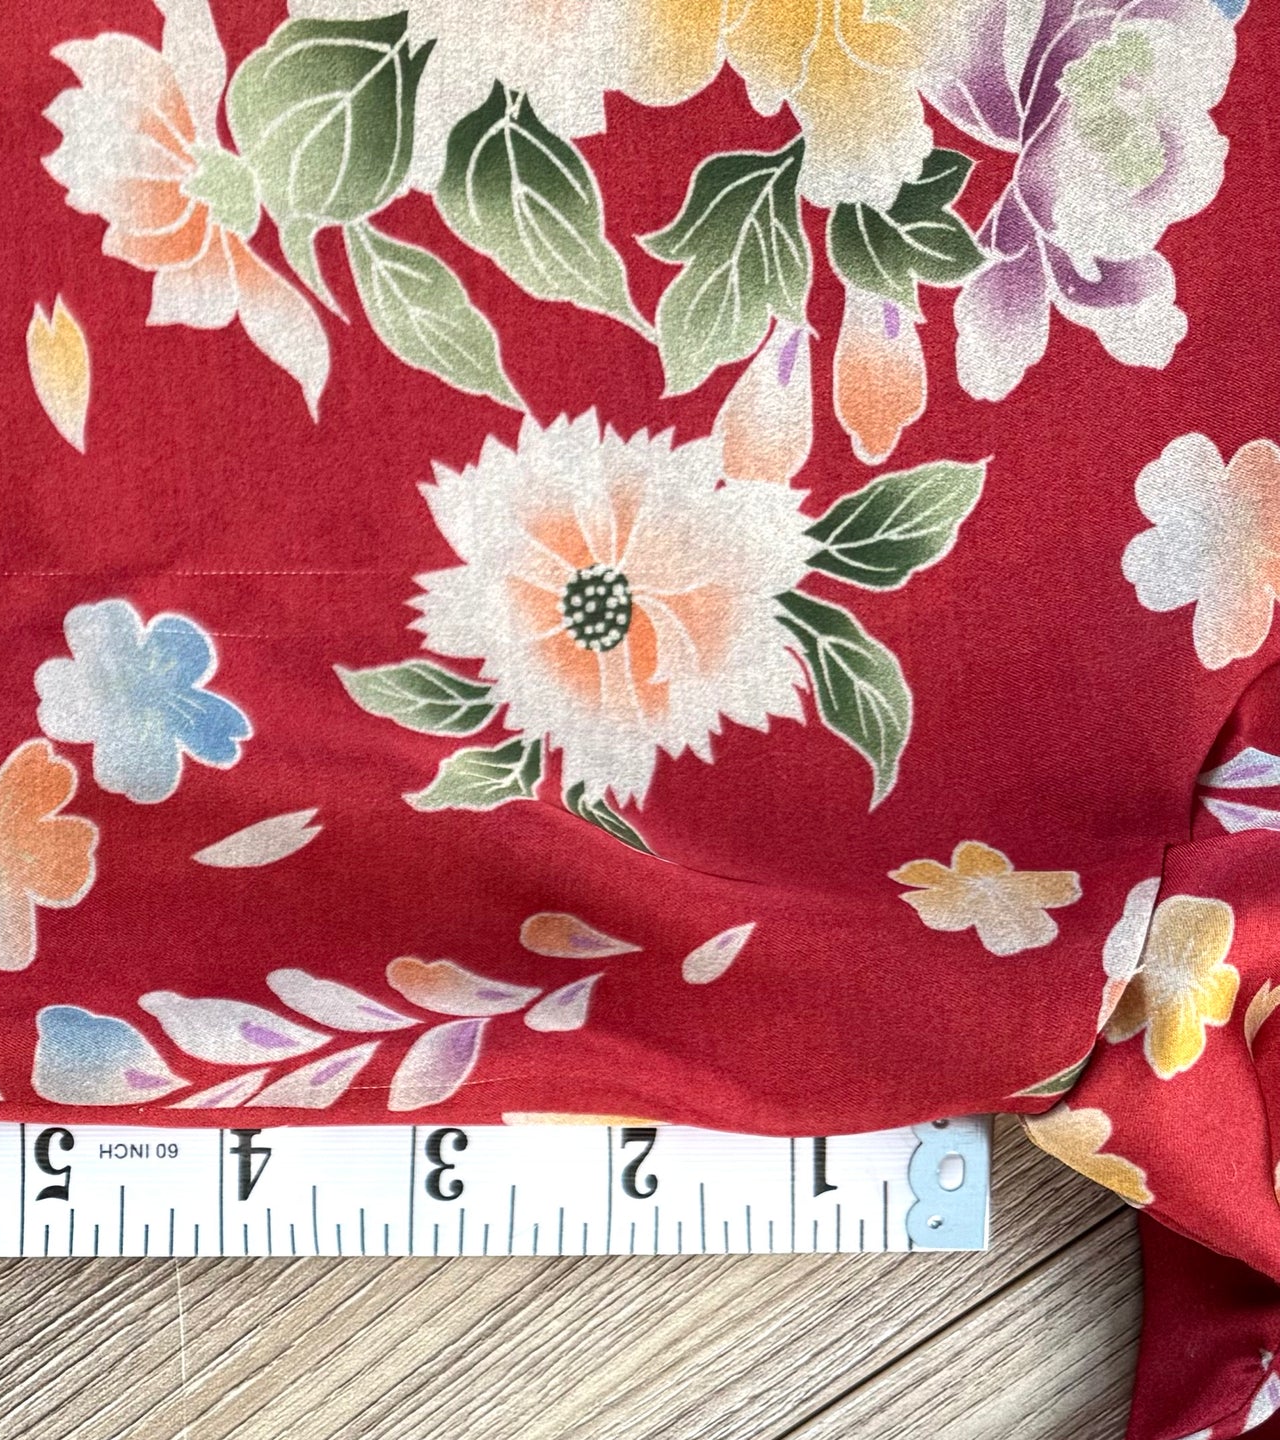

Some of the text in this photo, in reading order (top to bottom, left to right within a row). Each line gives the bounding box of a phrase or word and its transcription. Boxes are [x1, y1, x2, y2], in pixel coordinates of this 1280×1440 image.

[34, 1127, 74, 1200] 5
[99, 1143, 179, 1159] 60 INCH
[230, 1129, 272, 1201] 4
[425, 1128, 468, 1200] 3
[620, 1128, 658, 1199] 2
[813, 1137, 838, 1197] 1
